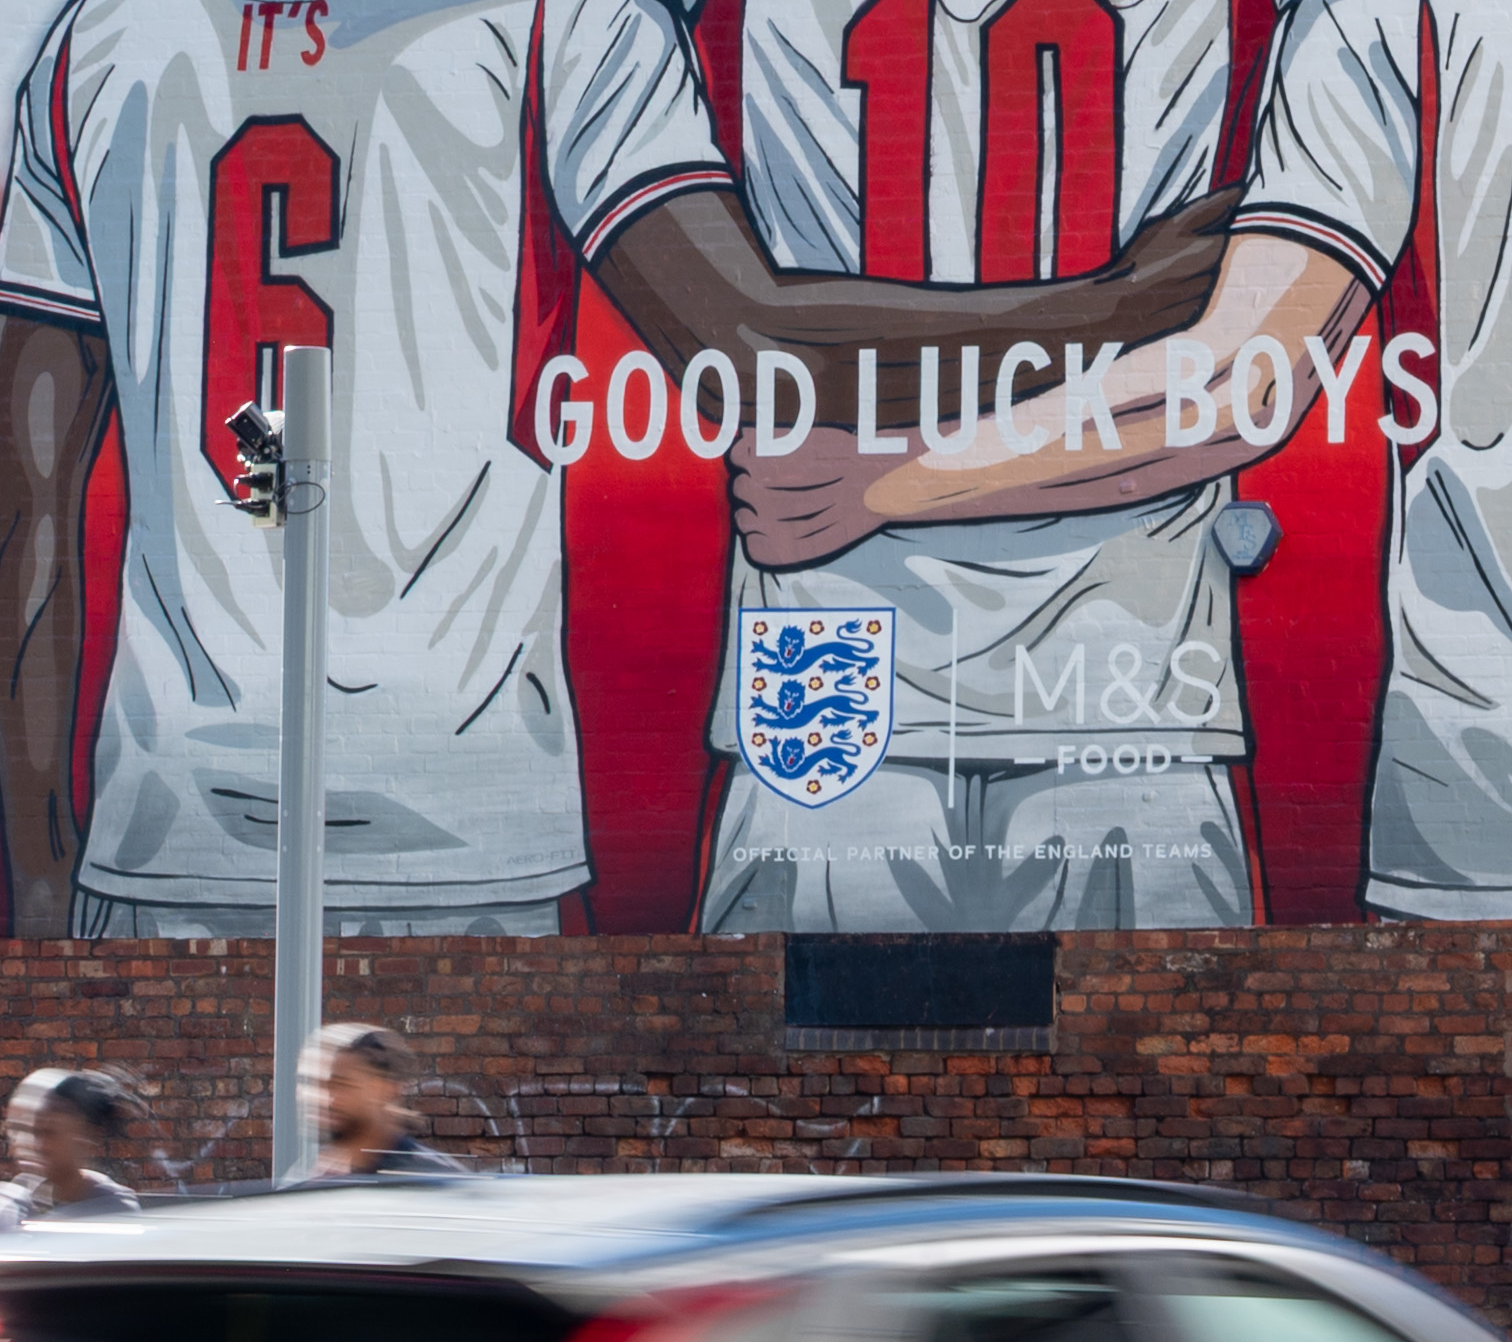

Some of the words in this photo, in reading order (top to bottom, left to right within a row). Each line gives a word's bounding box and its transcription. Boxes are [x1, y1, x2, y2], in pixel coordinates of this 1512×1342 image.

[201, 114, 341, 507] 6
[534, 349, 816, 465] GOOD
[857, 342, 1127, 456] LUCK
[1165, 332, 1440, 448] BOYS
[1014, 641, 1221, 725] M&S
[1057, 744, 1172, 775] FOOD
[733, 846, 837, 862] OFFICIAL
[847, 846, 940, 861] PARTNER
[949, 845, 977, 860] OF
[986, 845, 1024, 859] THE
[1035, 844, 1133, 859] ENGLAND
[1142, 843, 1213, 859] TEAMS
